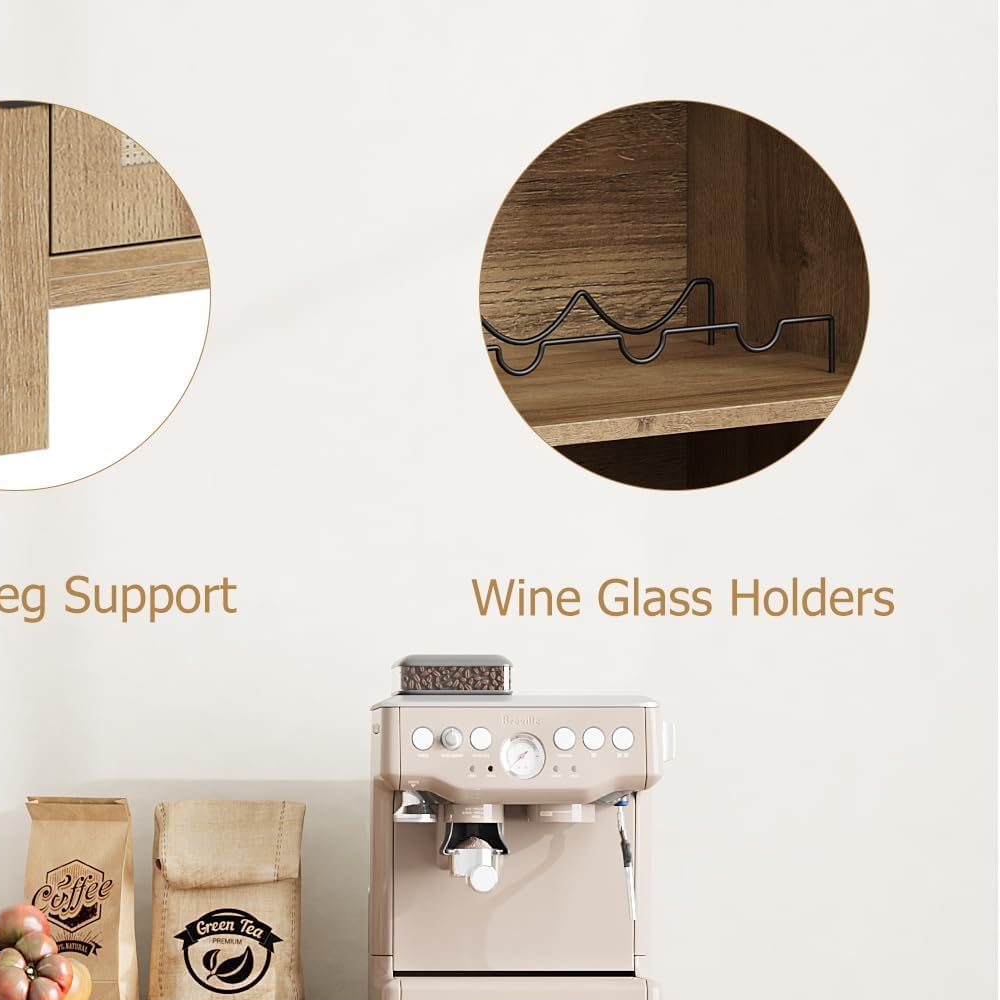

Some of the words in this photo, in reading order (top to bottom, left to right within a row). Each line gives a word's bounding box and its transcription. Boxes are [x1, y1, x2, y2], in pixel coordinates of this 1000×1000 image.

[31, 875, 114, 914] Coffee
[196, 920, 235, 935] Green
[240, 918, 264, 938] Tea
[65, 943, 88, 952] NATURAL
[212, 937, 243, 945] PREMIUM
